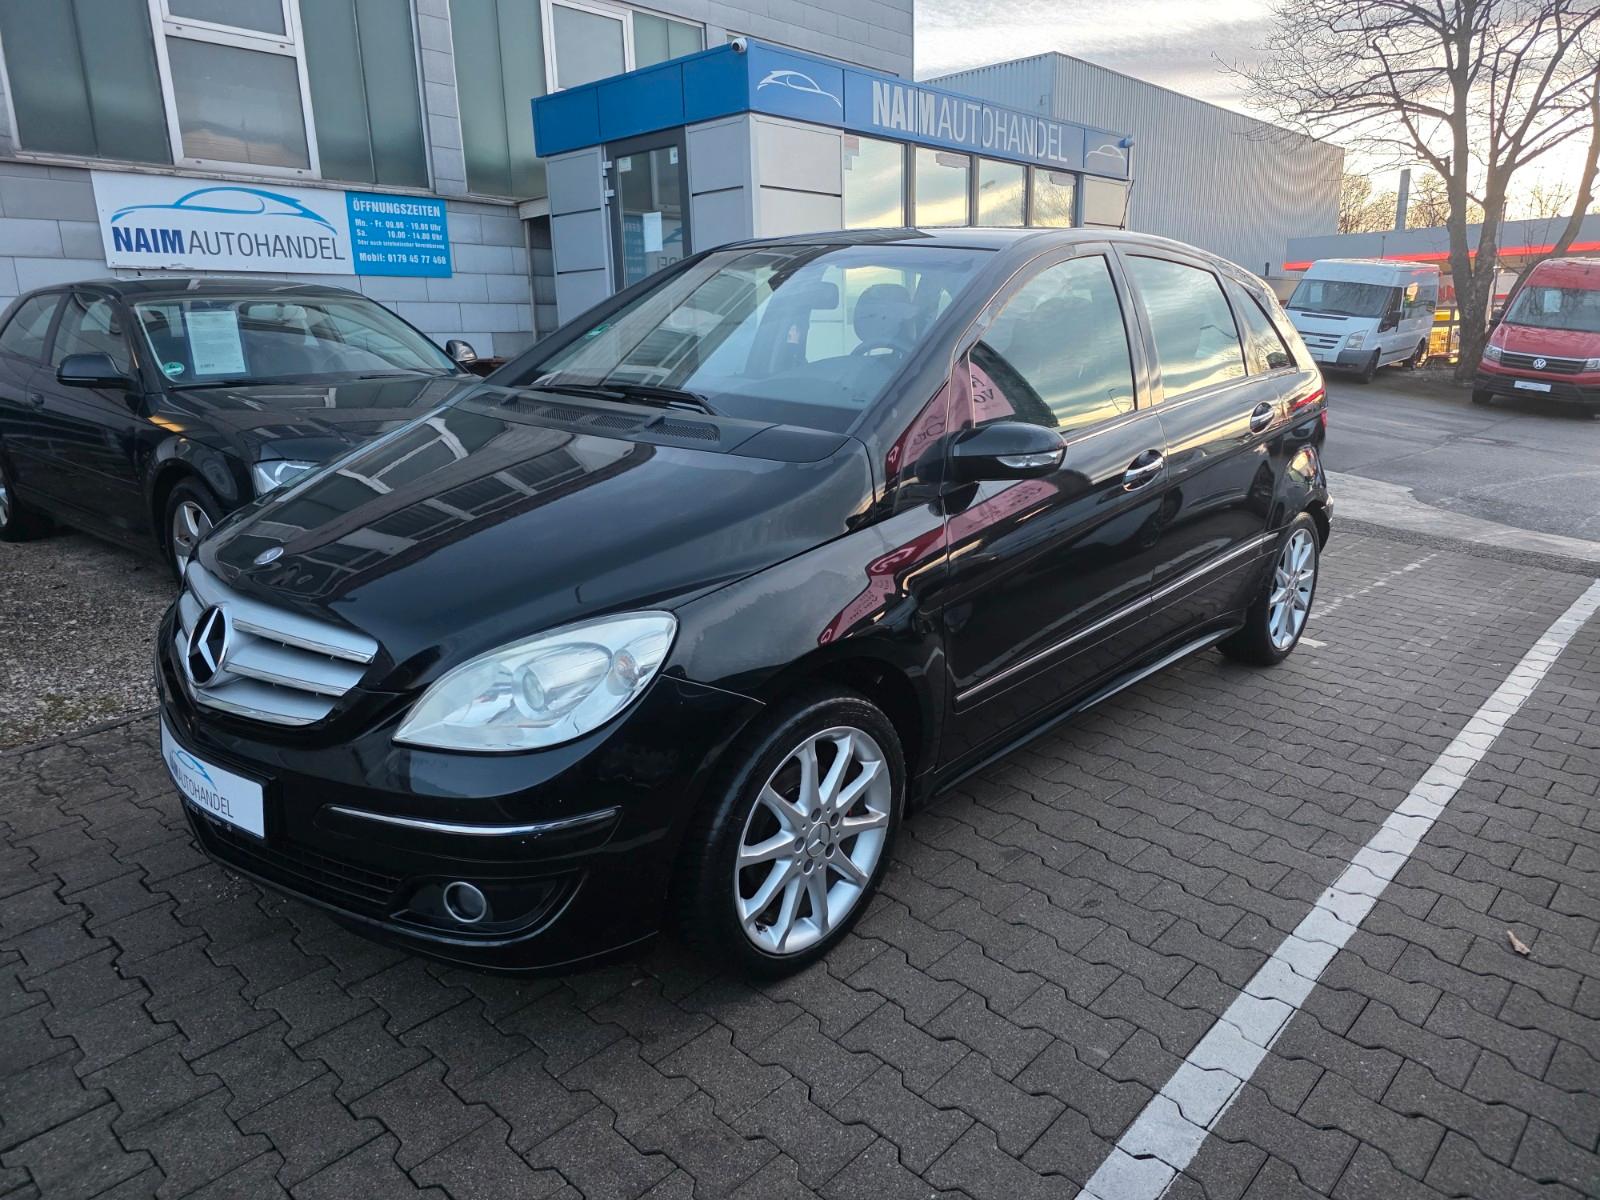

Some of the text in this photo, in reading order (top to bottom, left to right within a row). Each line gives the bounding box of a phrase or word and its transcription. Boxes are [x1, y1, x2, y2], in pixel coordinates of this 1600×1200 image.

[873, 81, 1068, 162] NAIM AUTOHANDEL
[353, 198, 440, 217] ÖFFNUNGSZEITEN
[356, 229, 368, 237] Sa.
[430, 223, 441, 231] Uhr
[112, 226, 346, 260] NAIM AUTOHANDEL
[359, 252, 385, 262] Mobil:
[387, 254, 407, 263] 0179
[409, 255, 419, 263] 45
[421, 255, 430, 264] 77
